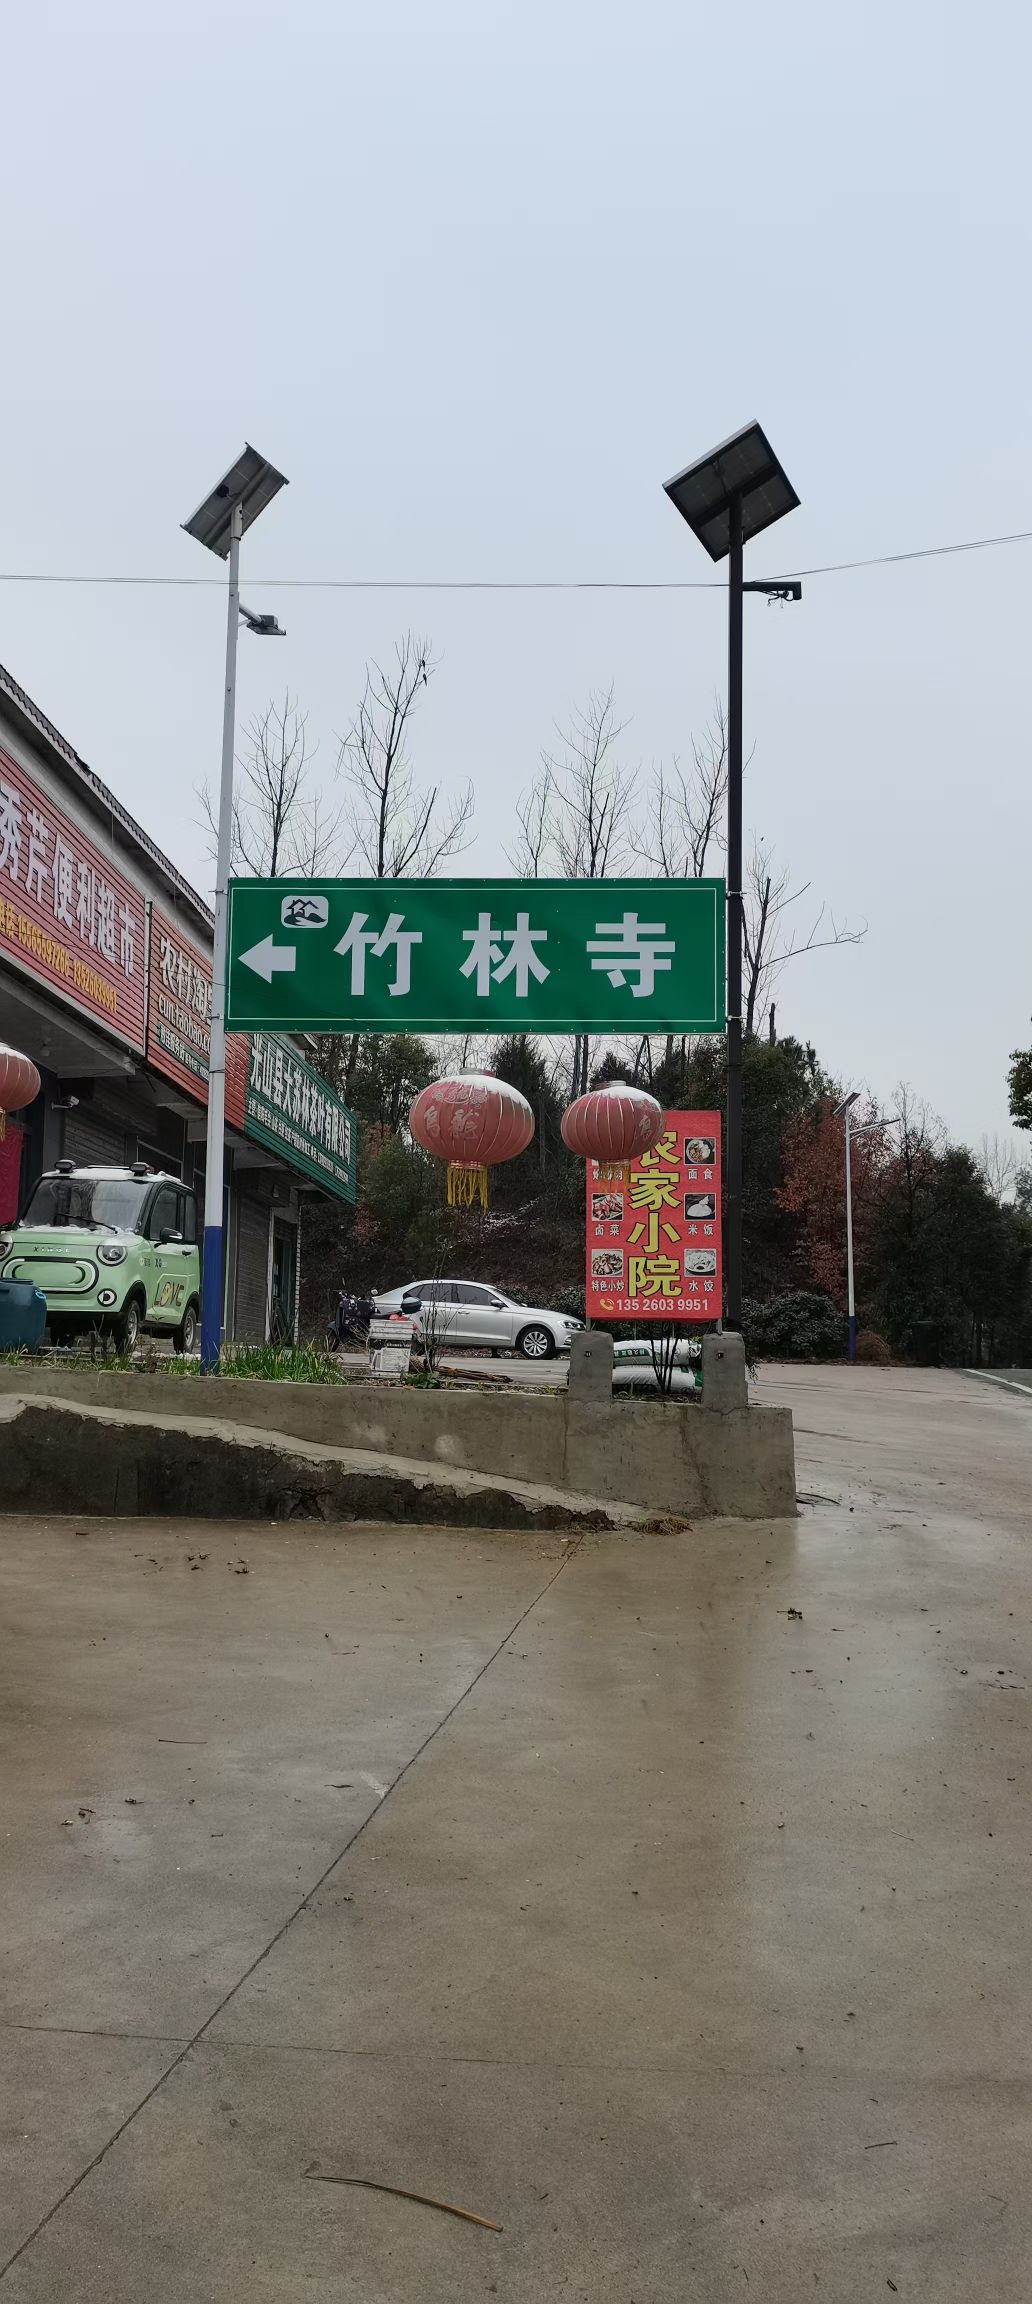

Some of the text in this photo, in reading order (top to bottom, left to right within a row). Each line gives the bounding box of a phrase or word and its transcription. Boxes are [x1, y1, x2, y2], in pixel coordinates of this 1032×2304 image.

[333, 911, 676, 998] 竹林寺
[159, 935, 212, 1024] 农村淘
[687, 1168, 713, 1181] 面食
[627, 1130, 683, 1298] 农家小院
[595, 1224, 620, 1236] 卤菜
[688, 1224, 714, 1236] 米饭
[591, 1279, 625, 1293] 特色小炒
[688, 1279, 714, 1293] 水饺
[616, 1299, 709, 1312] 135 2603 9951
